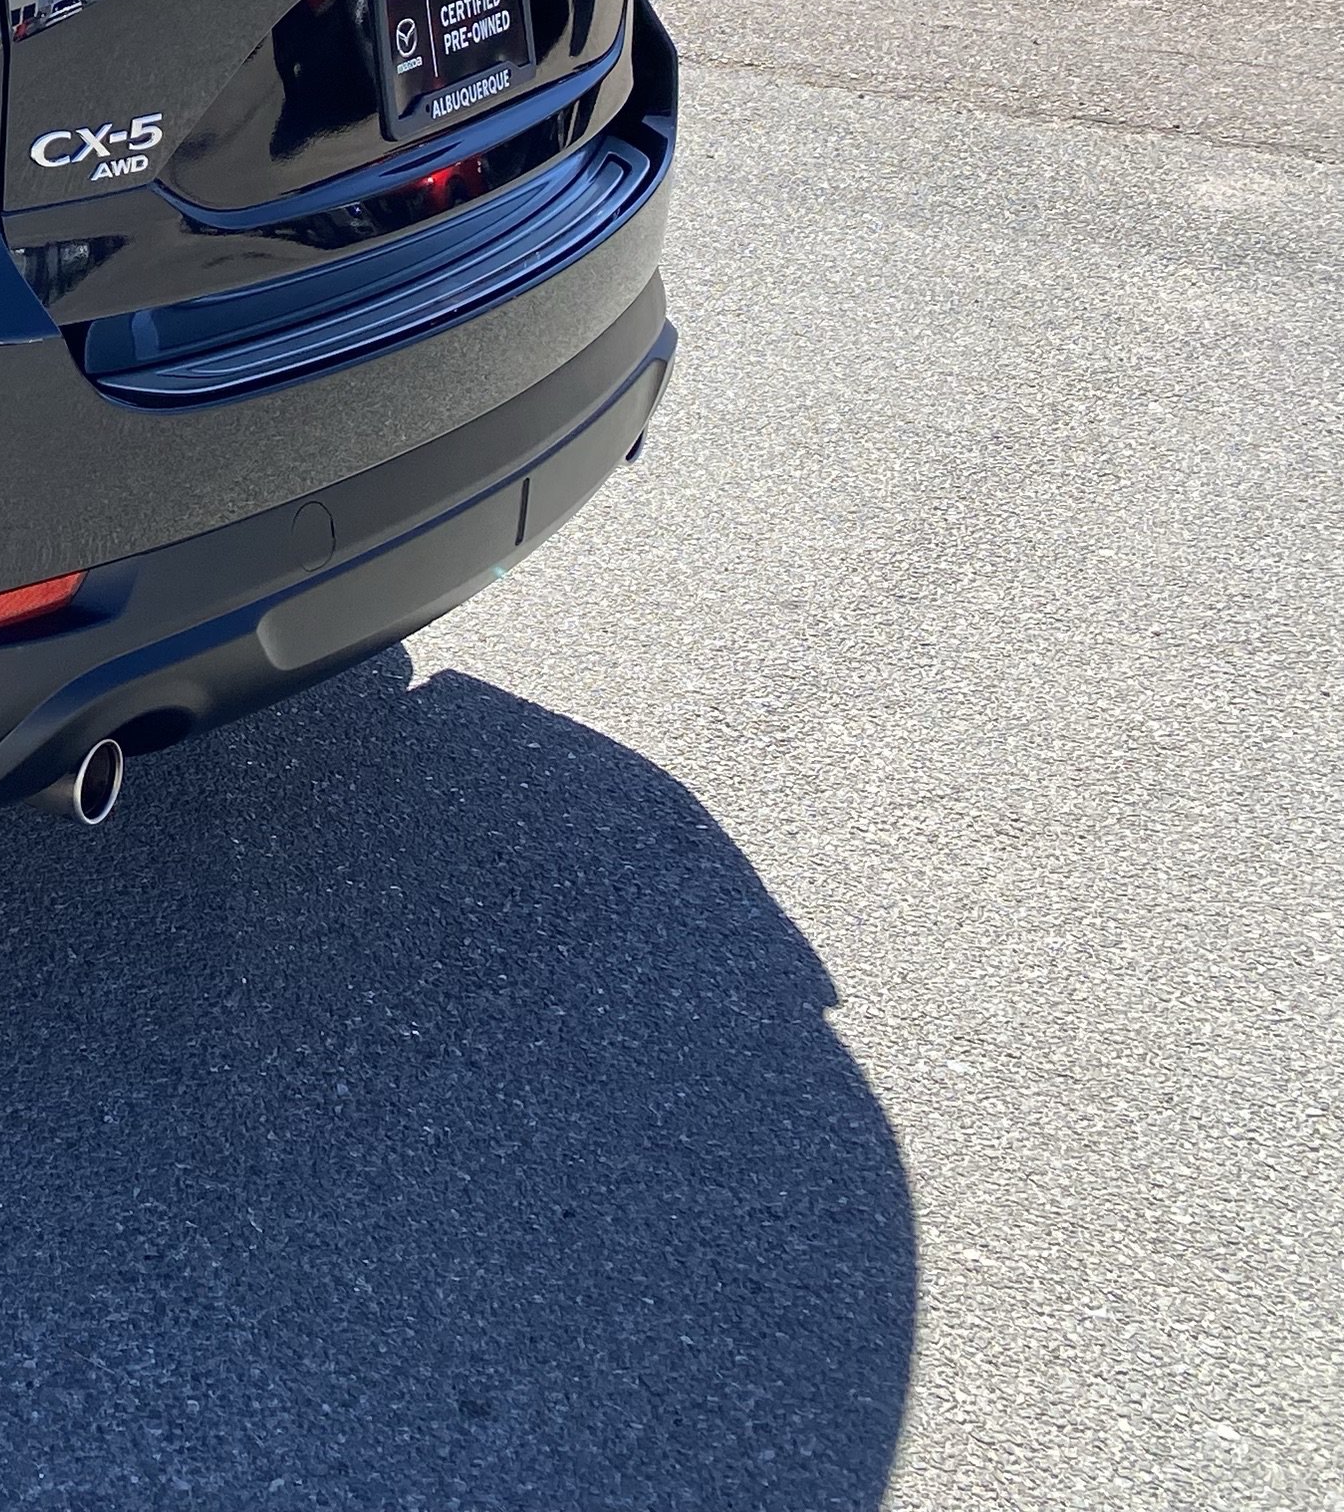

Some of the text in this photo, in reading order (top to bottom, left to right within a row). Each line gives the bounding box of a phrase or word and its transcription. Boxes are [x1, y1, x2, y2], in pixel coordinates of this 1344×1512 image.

[443, 10, 510, 55] PRE-OWNED
[432, 69, 510, 119] ALBUQUERQUE
[30, 113, 163, 168] CX-5
[89, 154, 149, 182] AWD
